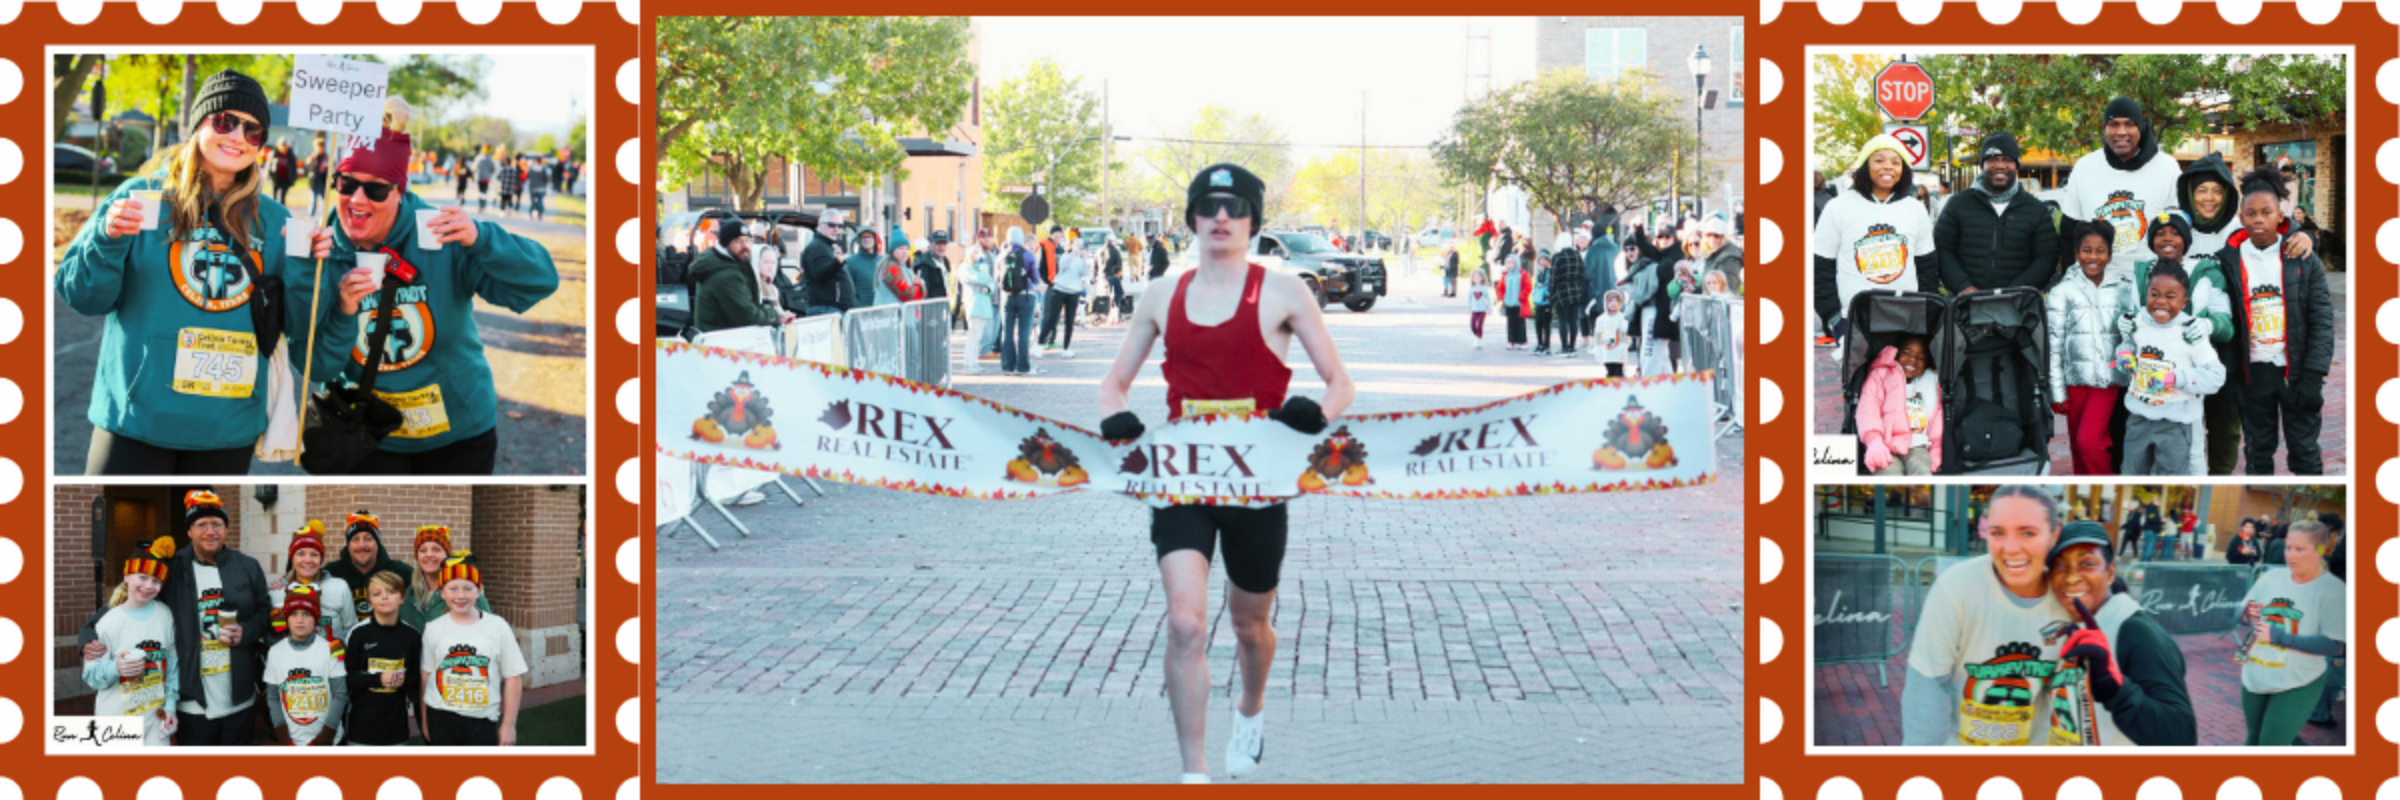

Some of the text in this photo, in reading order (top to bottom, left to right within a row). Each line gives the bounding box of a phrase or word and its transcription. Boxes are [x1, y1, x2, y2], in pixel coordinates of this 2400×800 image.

[295, 69, 386, 100] Sweeper
[1881, 80, 1929, 102] STOP
[309, 103, 364, 132] Party
[191, 351, 243, 382] 745
[855, 401, 956, 450] REX
[1441, 414, 1540, 453] REX
[817, 435, 876, 459] REAL
[1147, 442, 1257, 478] REX
[1405, 456, 1460, 477] REAL
[1814, 589, 1892, 627] elina
[446, 686, 485, 703] 2416
[1970, 720, 2019, 741] 268
